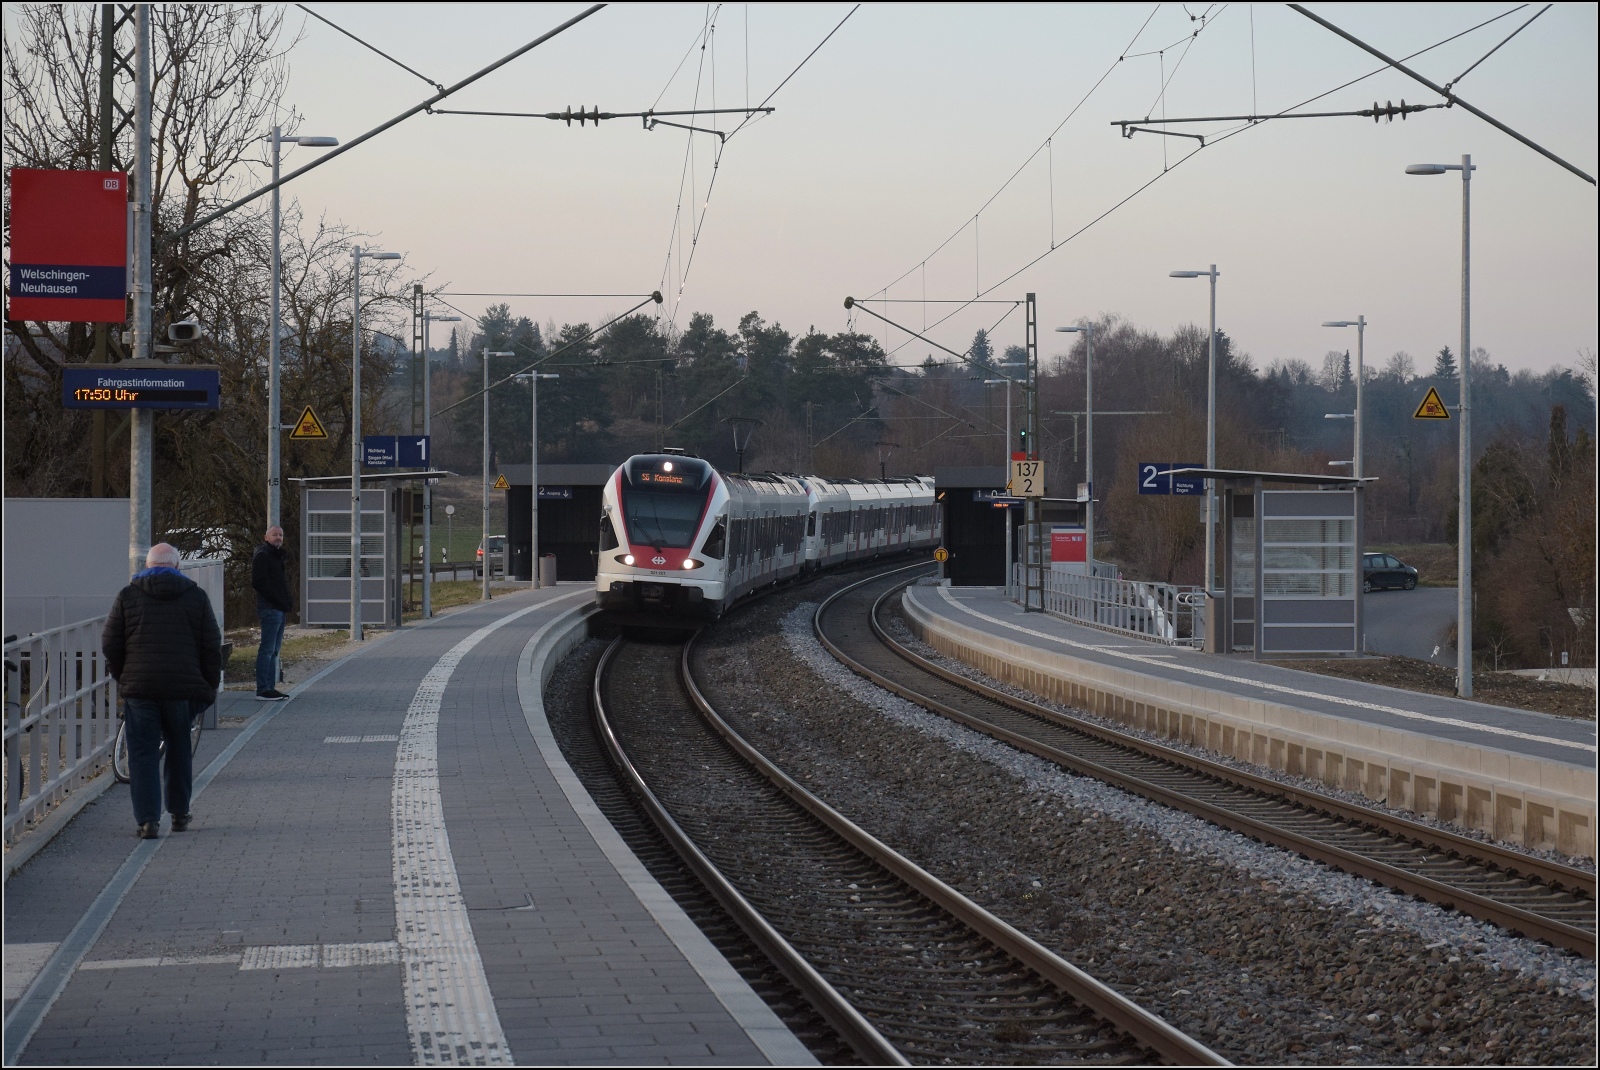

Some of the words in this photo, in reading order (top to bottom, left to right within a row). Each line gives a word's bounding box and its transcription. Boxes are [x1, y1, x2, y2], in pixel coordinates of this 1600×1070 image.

[104, 180, 118, 189] DB
[20, 269, 90, 282] Welschingen-
[20, 282, 78, 293] Neuhausen
[97, 377, 185, 388] Fahrgastinformation
[74, 389, 111, 400] 17:50
[115, 389, 139, 400] Uhr
[416, 438, 426, 460] 1
[1016, 462, 1039, 477] 137
[654, 474, 683, 483] Konstanz
[1143, 465, 1157, 488] 2
[539, 486, 545, 496] 2
[1023, 478, 1033, 493] 2
